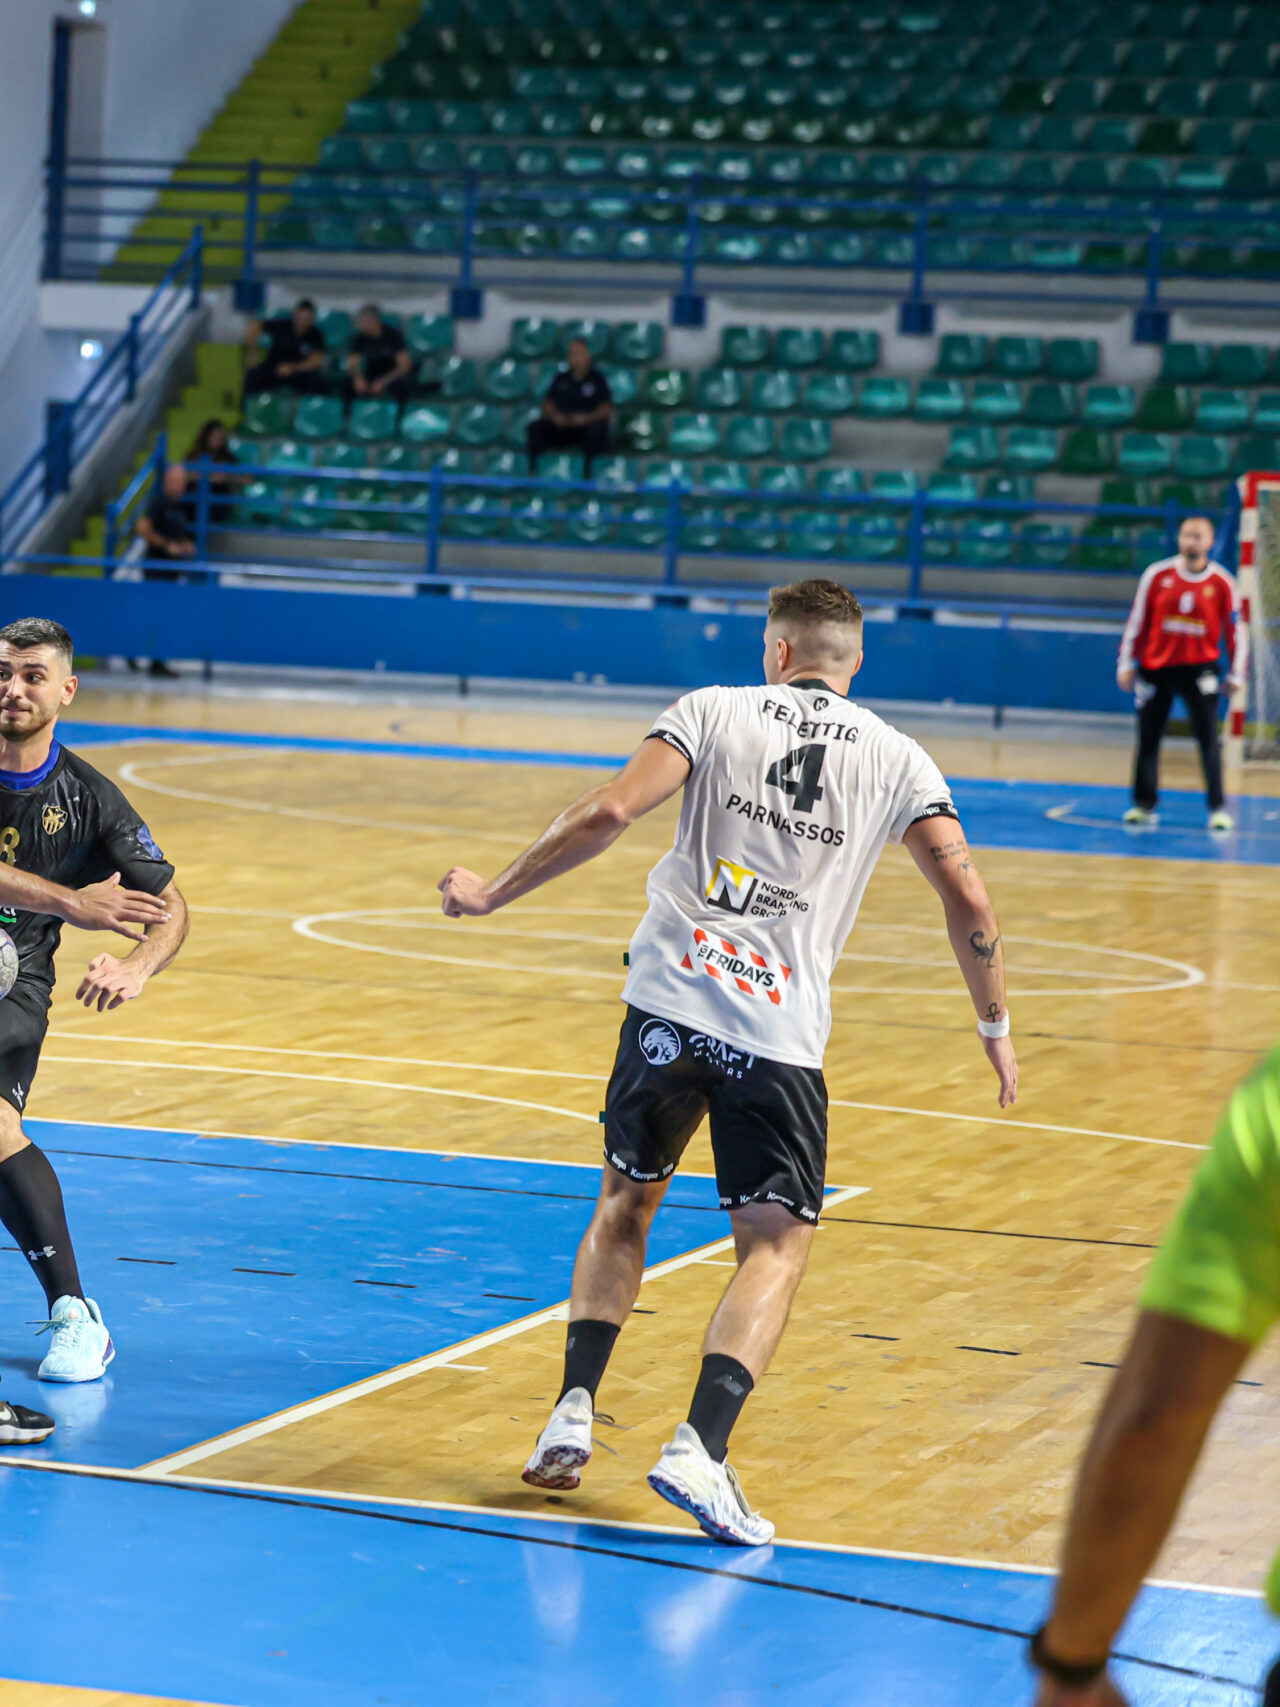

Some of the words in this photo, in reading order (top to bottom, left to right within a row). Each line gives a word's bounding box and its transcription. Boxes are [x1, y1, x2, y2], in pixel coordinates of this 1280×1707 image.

[765, 743, 827, 814] 4
[726, 793, 846, 847] PARNASSOS
[705, 948, 775, 987] FRIDAYS
[630, 1167, 659, 1182] Kempa
